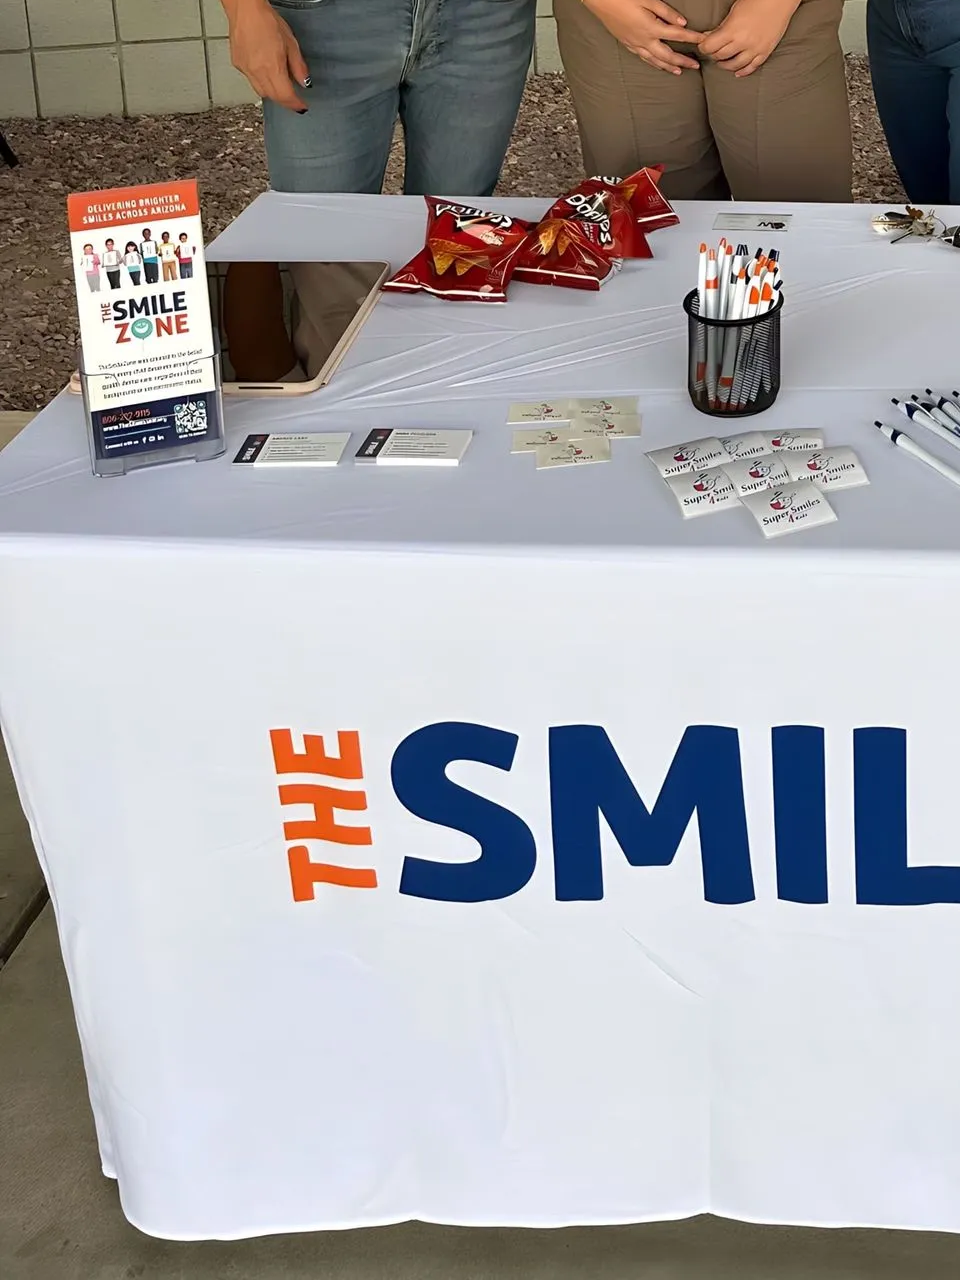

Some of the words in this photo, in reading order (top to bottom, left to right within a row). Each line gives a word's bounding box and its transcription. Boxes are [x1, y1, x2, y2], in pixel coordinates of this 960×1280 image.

[82, 212, 114, 225] SMILES
[115, 208, 149, 220] ACROSS
[150, 203, 187, 215] ARIZONA
[87, 199, 137, 214] DELIVERING
[139, 194, 180, 208] BRIGHTER
[100, 302, 112, 324] THE
[112, 291, 187, 321] SMILE
[114, 313, 190, 344] ZONE
[664, 462, 691, 475] Super
[693, 451, 722, 464] Smiles
[735, 446, 764, 459] Smiles
[826, 463, 855, 474] Smiles
[740, 480, 767, 492] Super
[769, 470, 789, 481] Smil
[683, 493, 711, 505] Super
[713, 483, 735, 495] Smil
[762, 510, 789, 526] Super
[790, 499, 821, 514] Smiles
[269, 727, 377, 903] THE
